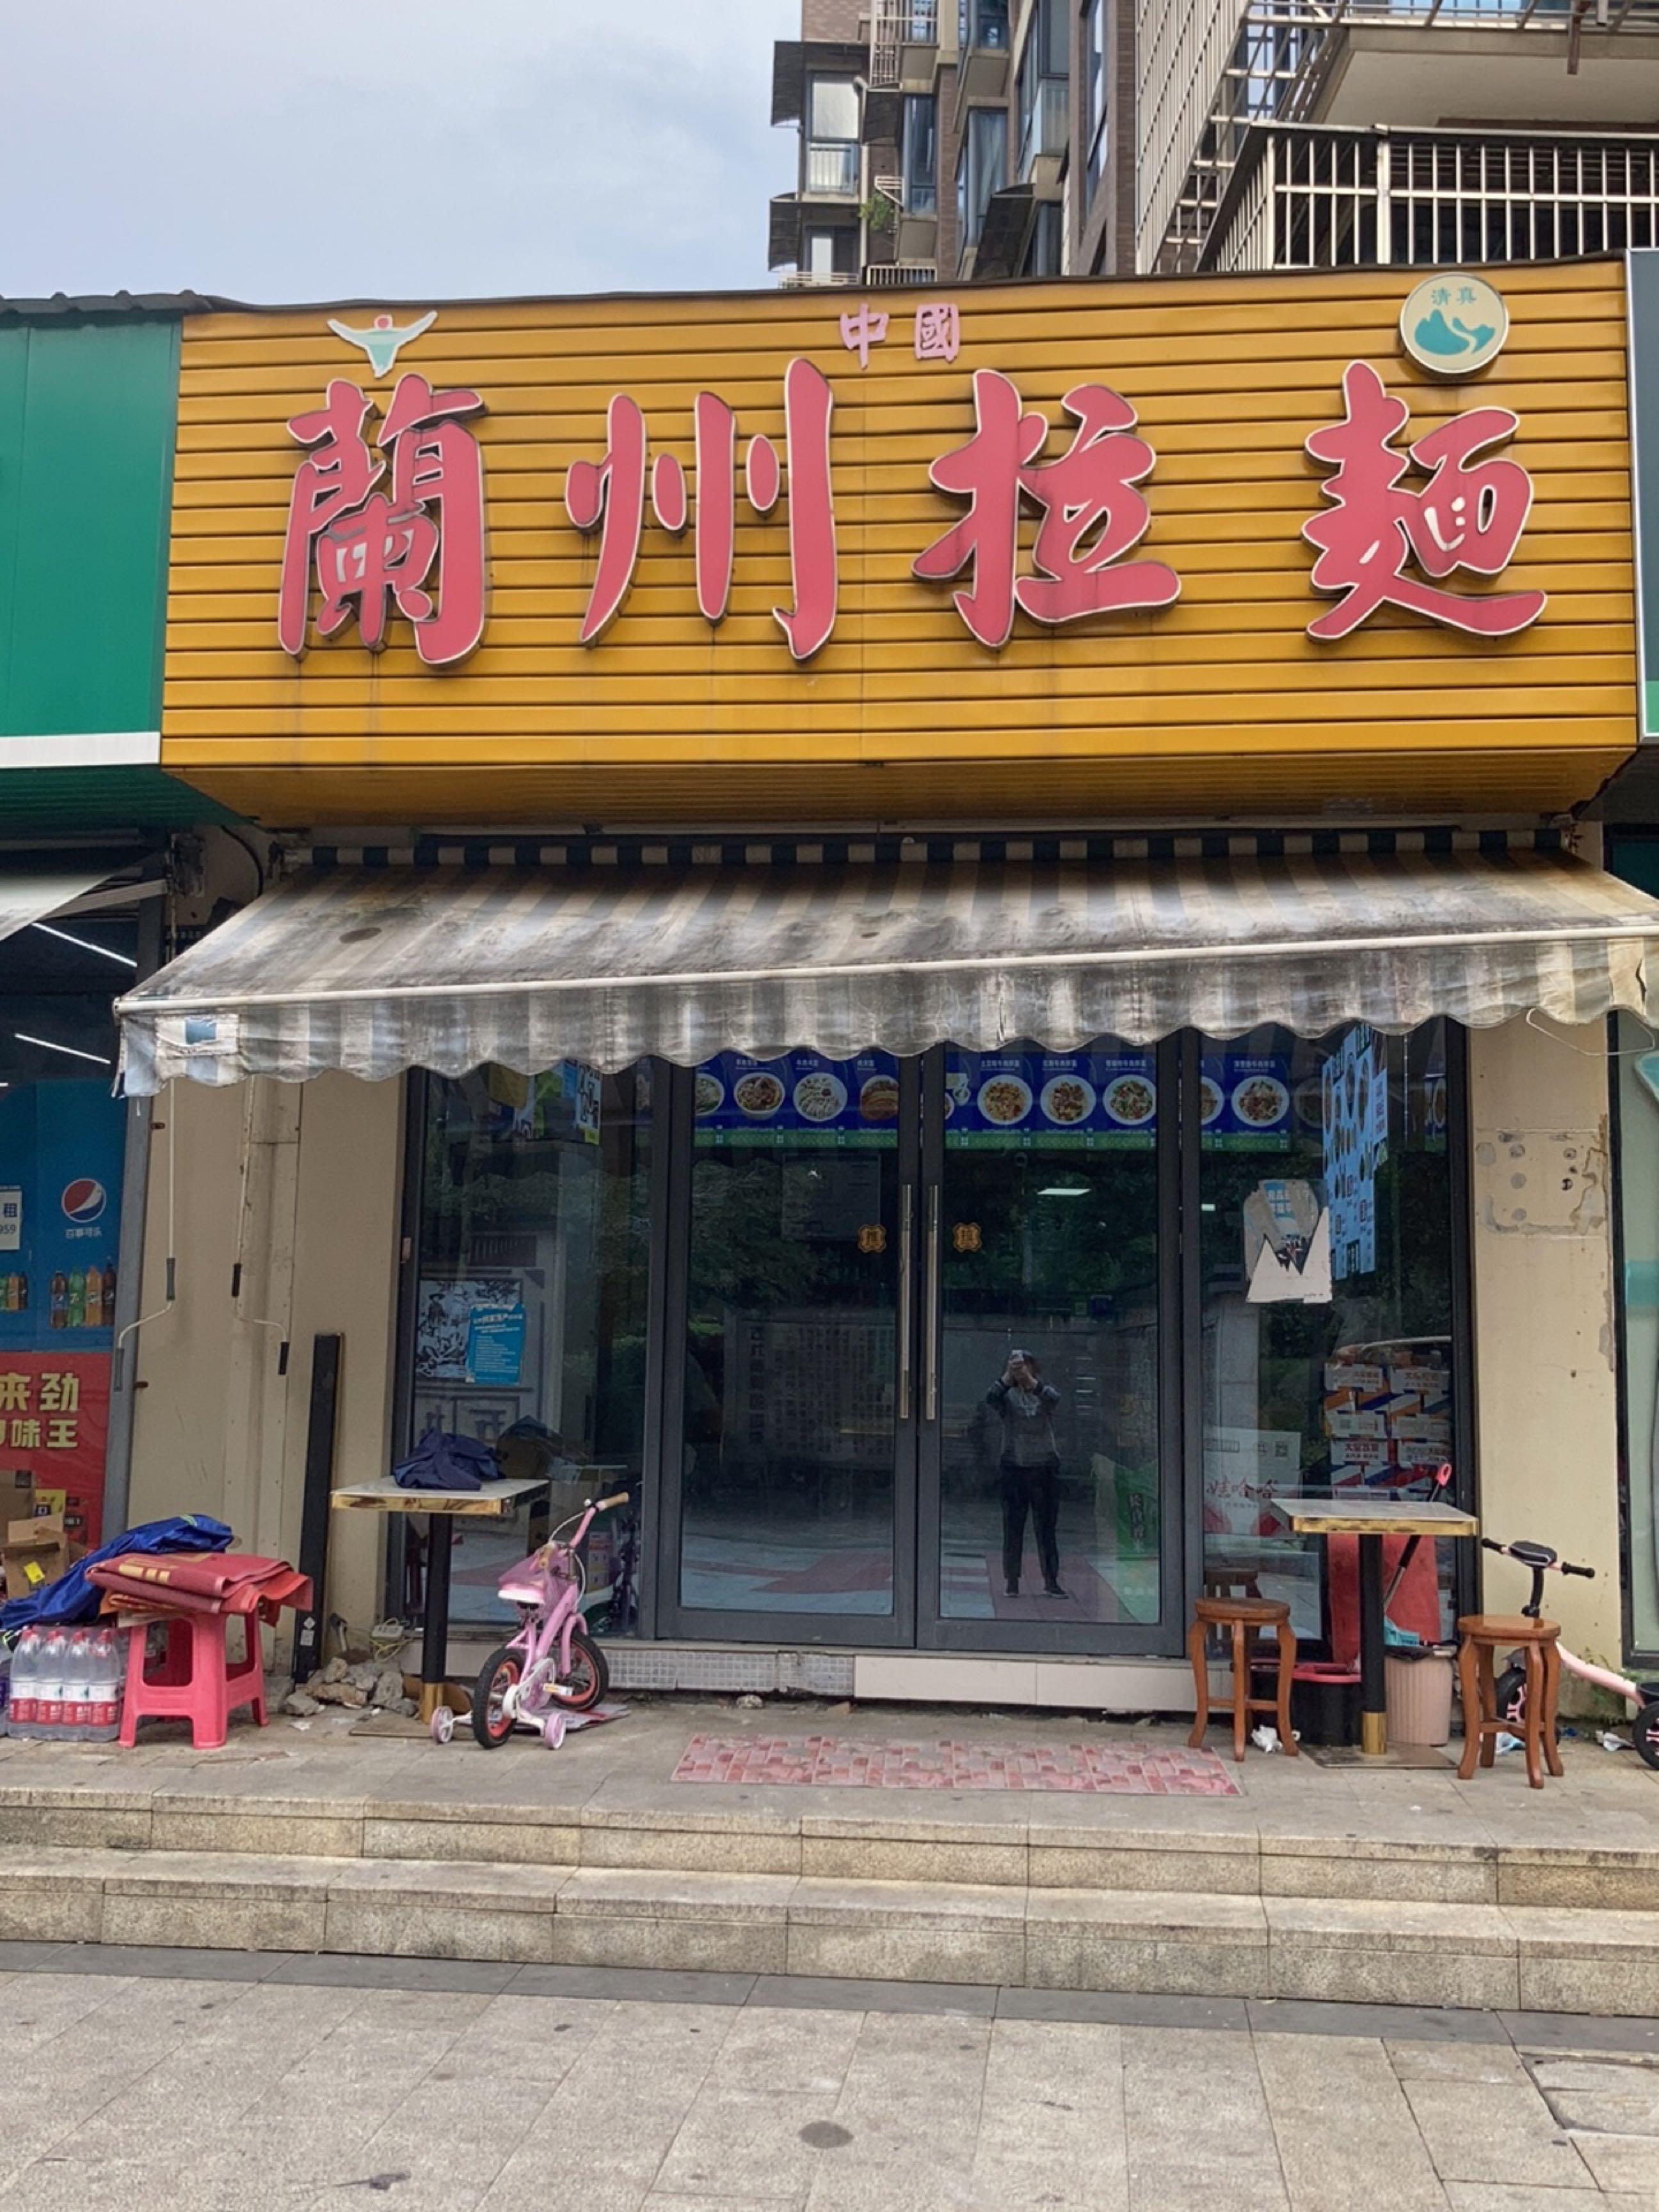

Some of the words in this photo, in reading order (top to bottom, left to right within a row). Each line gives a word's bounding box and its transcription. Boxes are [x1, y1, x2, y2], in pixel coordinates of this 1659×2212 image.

[1431, 285, 1477, 306] 清真
[839, 302, 959, 371] 中國
[0, 1418, 78, 1448] 味王
